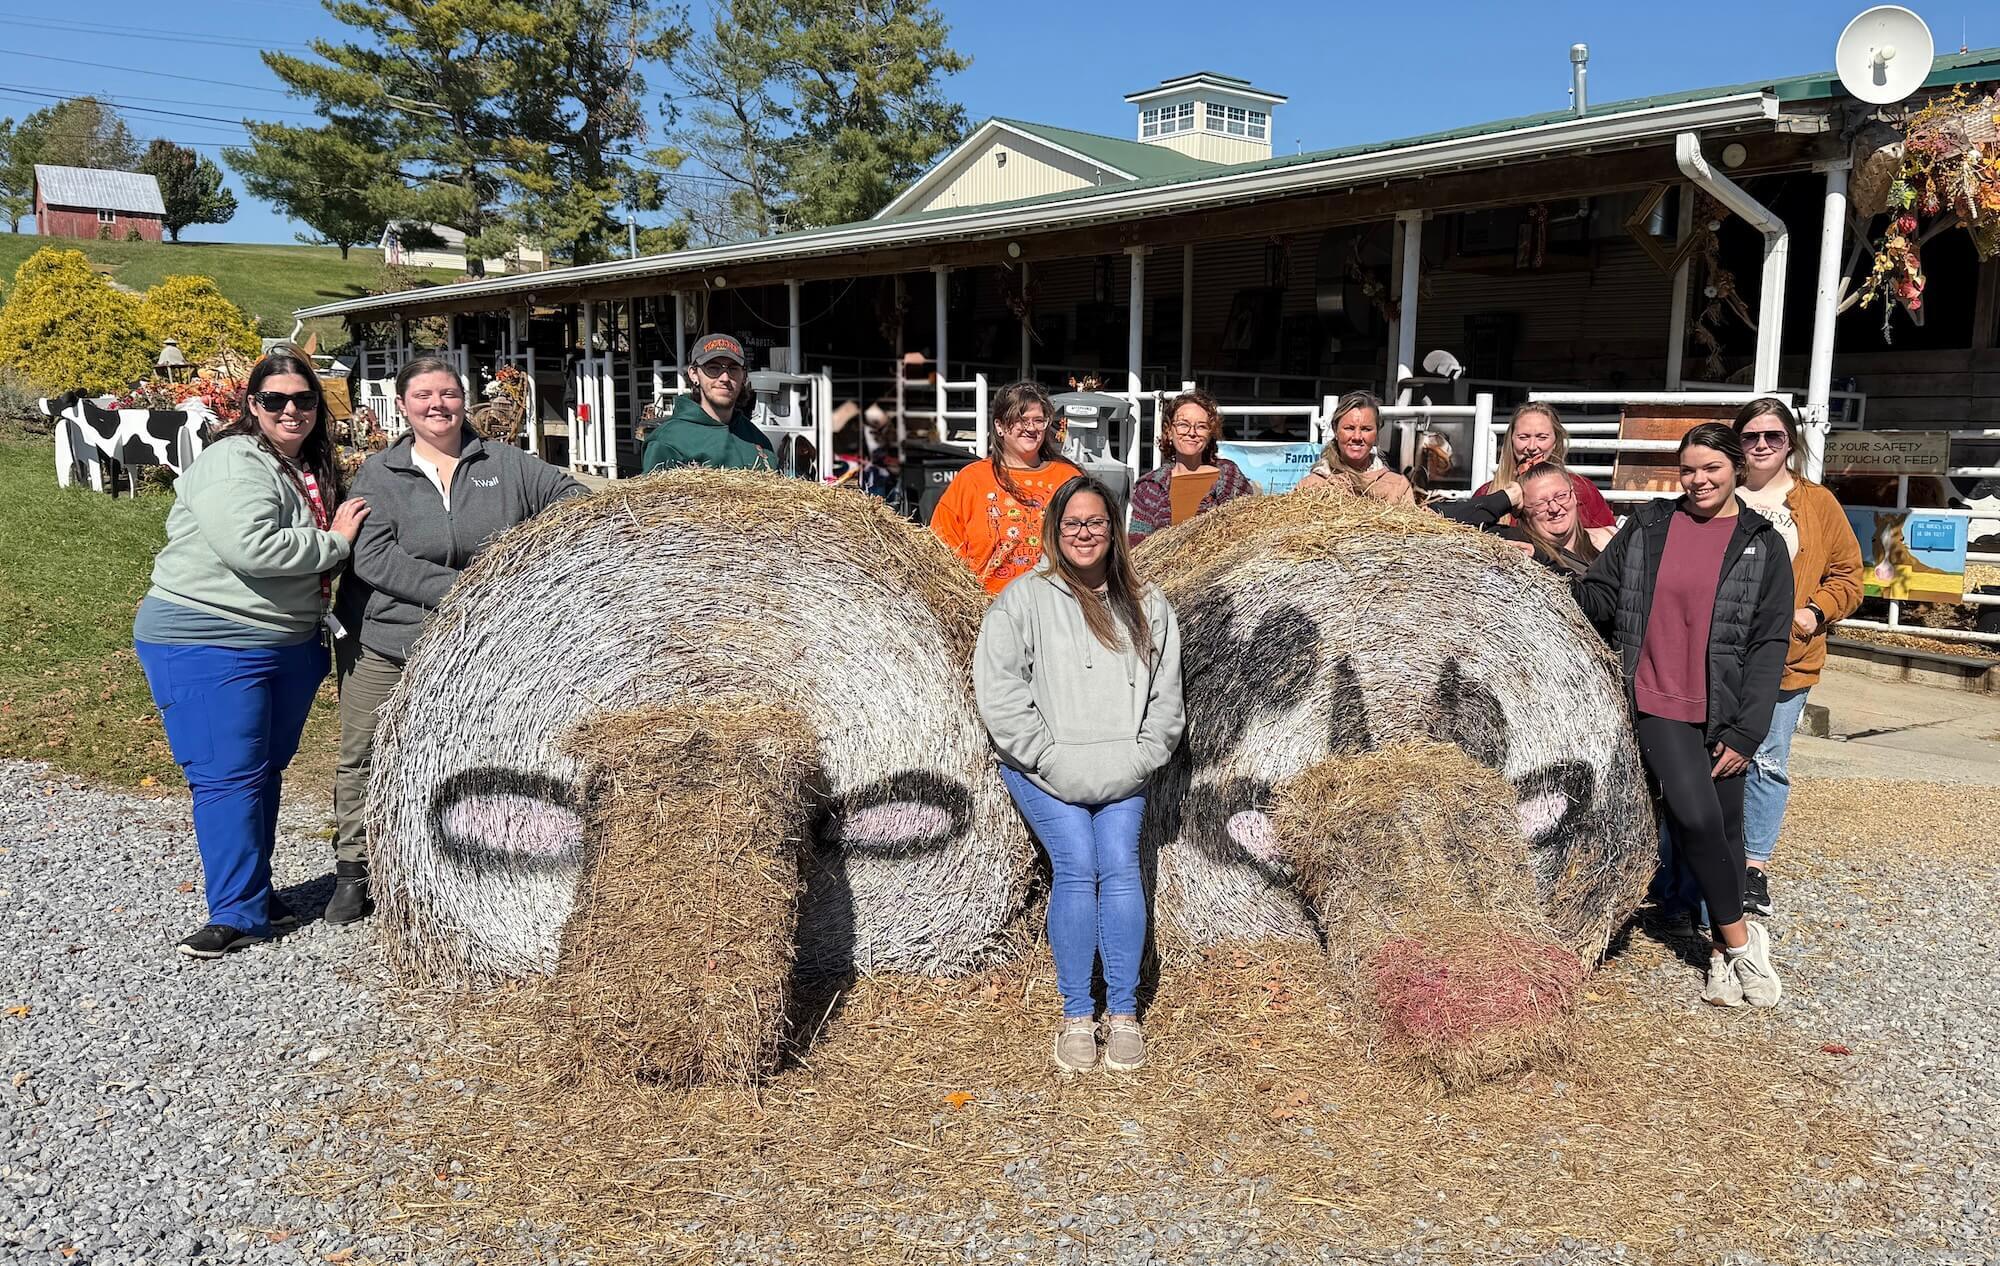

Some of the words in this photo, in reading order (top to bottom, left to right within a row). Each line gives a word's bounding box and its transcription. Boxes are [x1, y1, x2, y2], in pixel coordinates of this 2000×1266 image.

[1840, 442, 1869, 451] YOUR
[1873, 442, 1922, 452] SAFETY
[1285, 453, 1313, 463] Farm
[1824, 454, 1839, 463] OT
[1841, 454, 1880, 464] TOUCH
[1883, 455, 1900, 464] OR
[1904, 455, 1939, 465] FEED
